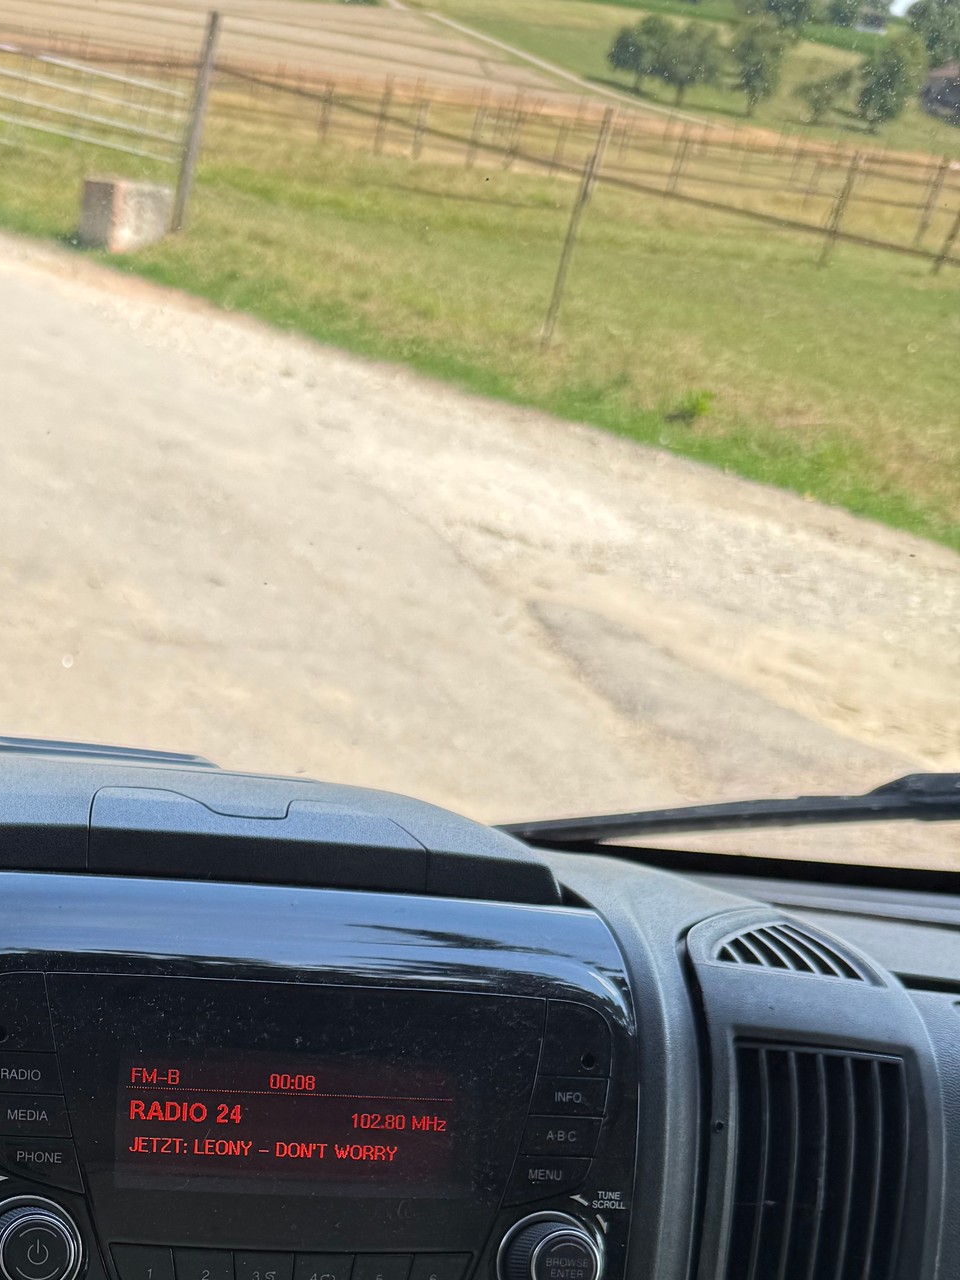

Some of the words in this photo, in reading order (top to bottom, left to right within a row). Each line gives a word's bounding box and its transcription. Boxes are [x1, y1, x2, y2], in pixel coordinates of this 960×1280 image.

[0, 1068, 41, 1081] RADIO
[269, 1073, 316, 1091] 00:08
[554, 1091, 582, 1103] INFO
[6, 1109, 48, 1121] MEDIA
[129, 1100, 208, 1122] RADIO
[216, 1103, 242, 1124] 24
[351, 1113, 406, 1130] 102.80
[411, 1115, 447, 1132] MHz
[128, 1136, 189, 1154] JETZT:
[193, 1138, 253, 1156] LEONY
[275, 1141, 328, 1159] DON'T
[334, 1143, 398, 1161] WORRY
[16, 1150, 62, 1163] PHONE
[528, 1168, 562, 1181] MENU
[597, 1190, 621, 1200] TUNE
[591, 1199, 626, 1210] SCROLL
[545, 1256, 589, 1268] BROWSE
[146, 1267, 153, 1280] 1
[550, 1267, 584, 1279] ENTER
